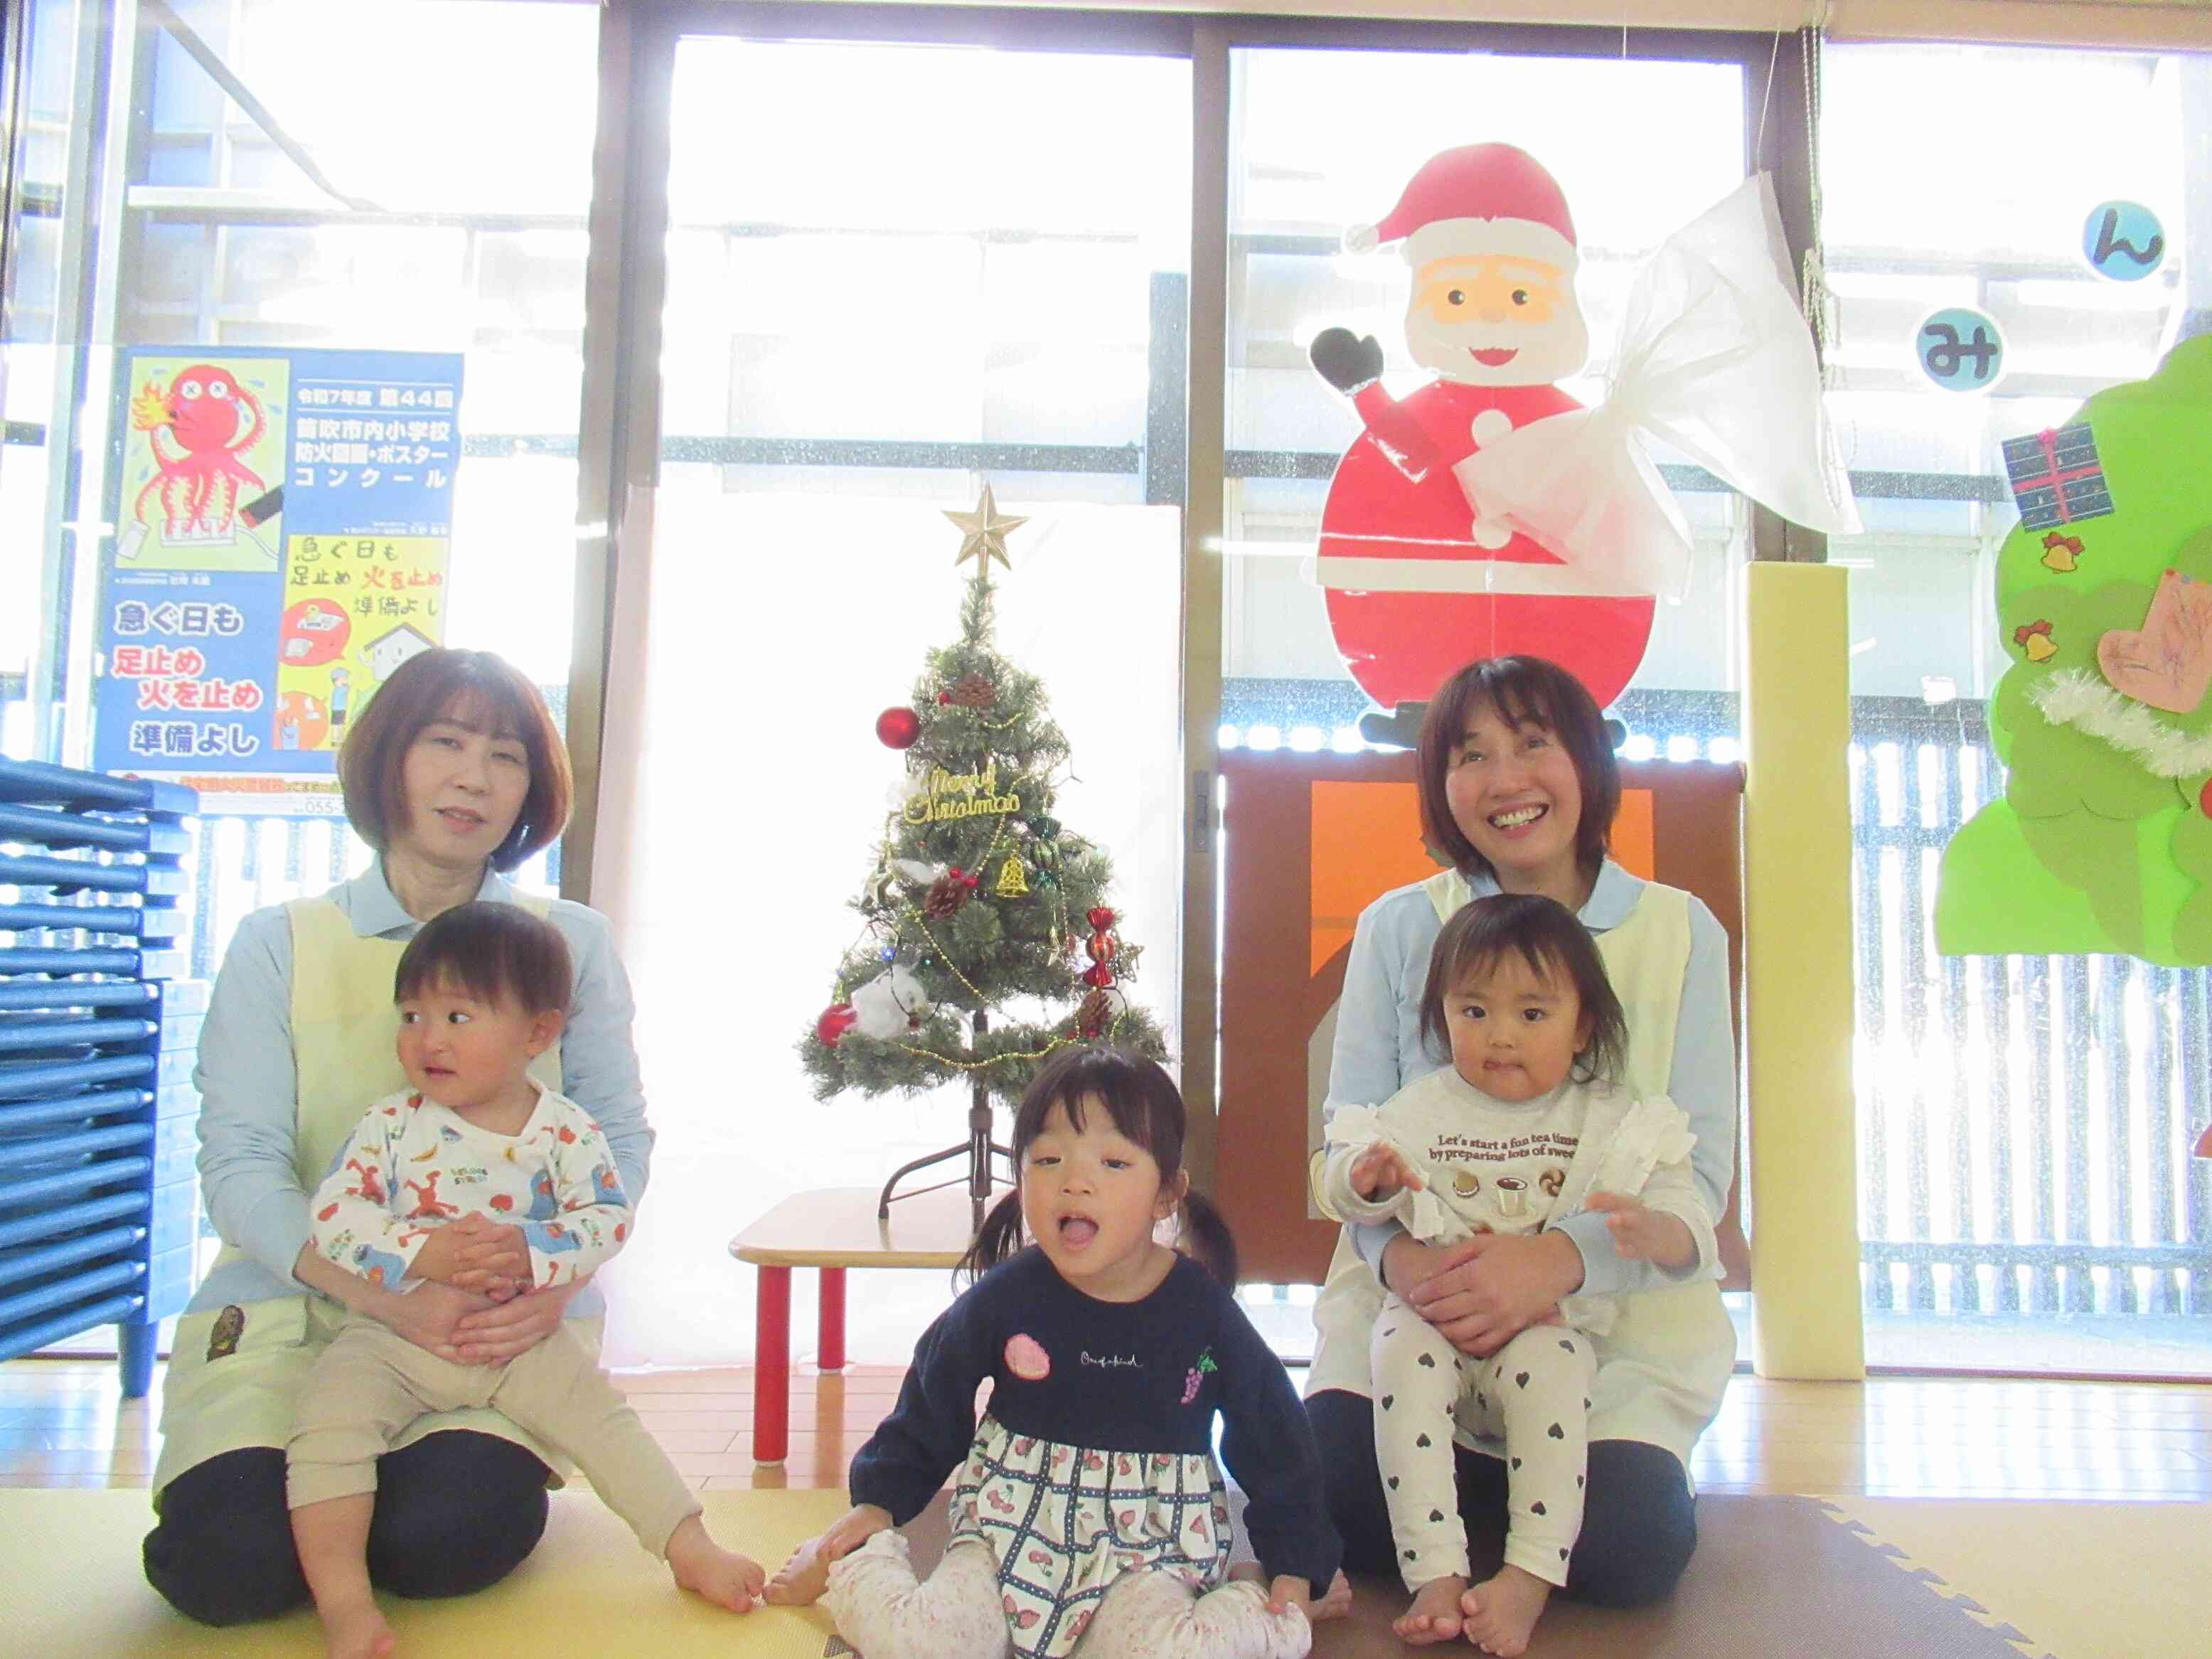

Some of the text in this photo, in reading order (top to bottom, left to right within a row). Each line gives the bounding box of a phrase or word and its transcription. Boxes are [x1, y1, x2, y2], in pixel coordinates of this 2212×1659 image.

[2093, 208, 2163, 264] ん
[1925, 324, 1998, 379] み
[295, 467, 447, 489] コンクール
[295, 537, 398, 562] 急ぐ日も
[290, 565, 444, 590] 足止め 火を止め
[115, 601, 243, 635] 急ぐ日も
[355, 595, 439, 617] 準備よし
[112, 644, 204, 677] 足止め
[139, 678, 262, 712] 火を止め
[131, 720, 258, 756] 準備よし
[1428, 1148, 1443, 1163] by
[1445, 1149, 1507, 1161] preparing
[1508, 1150, 1530, 1158] lots
[1532, 1143, 1546, 1156] of
[1438, 1133, 1468, 1146] Let's
[1470, 1139, 1498, 1150] start
[1510, 1138, 1529, 1148] fun
[1531, 1133, 1551, 1143] tea
[1552, 1132, 1579, 1146] time
